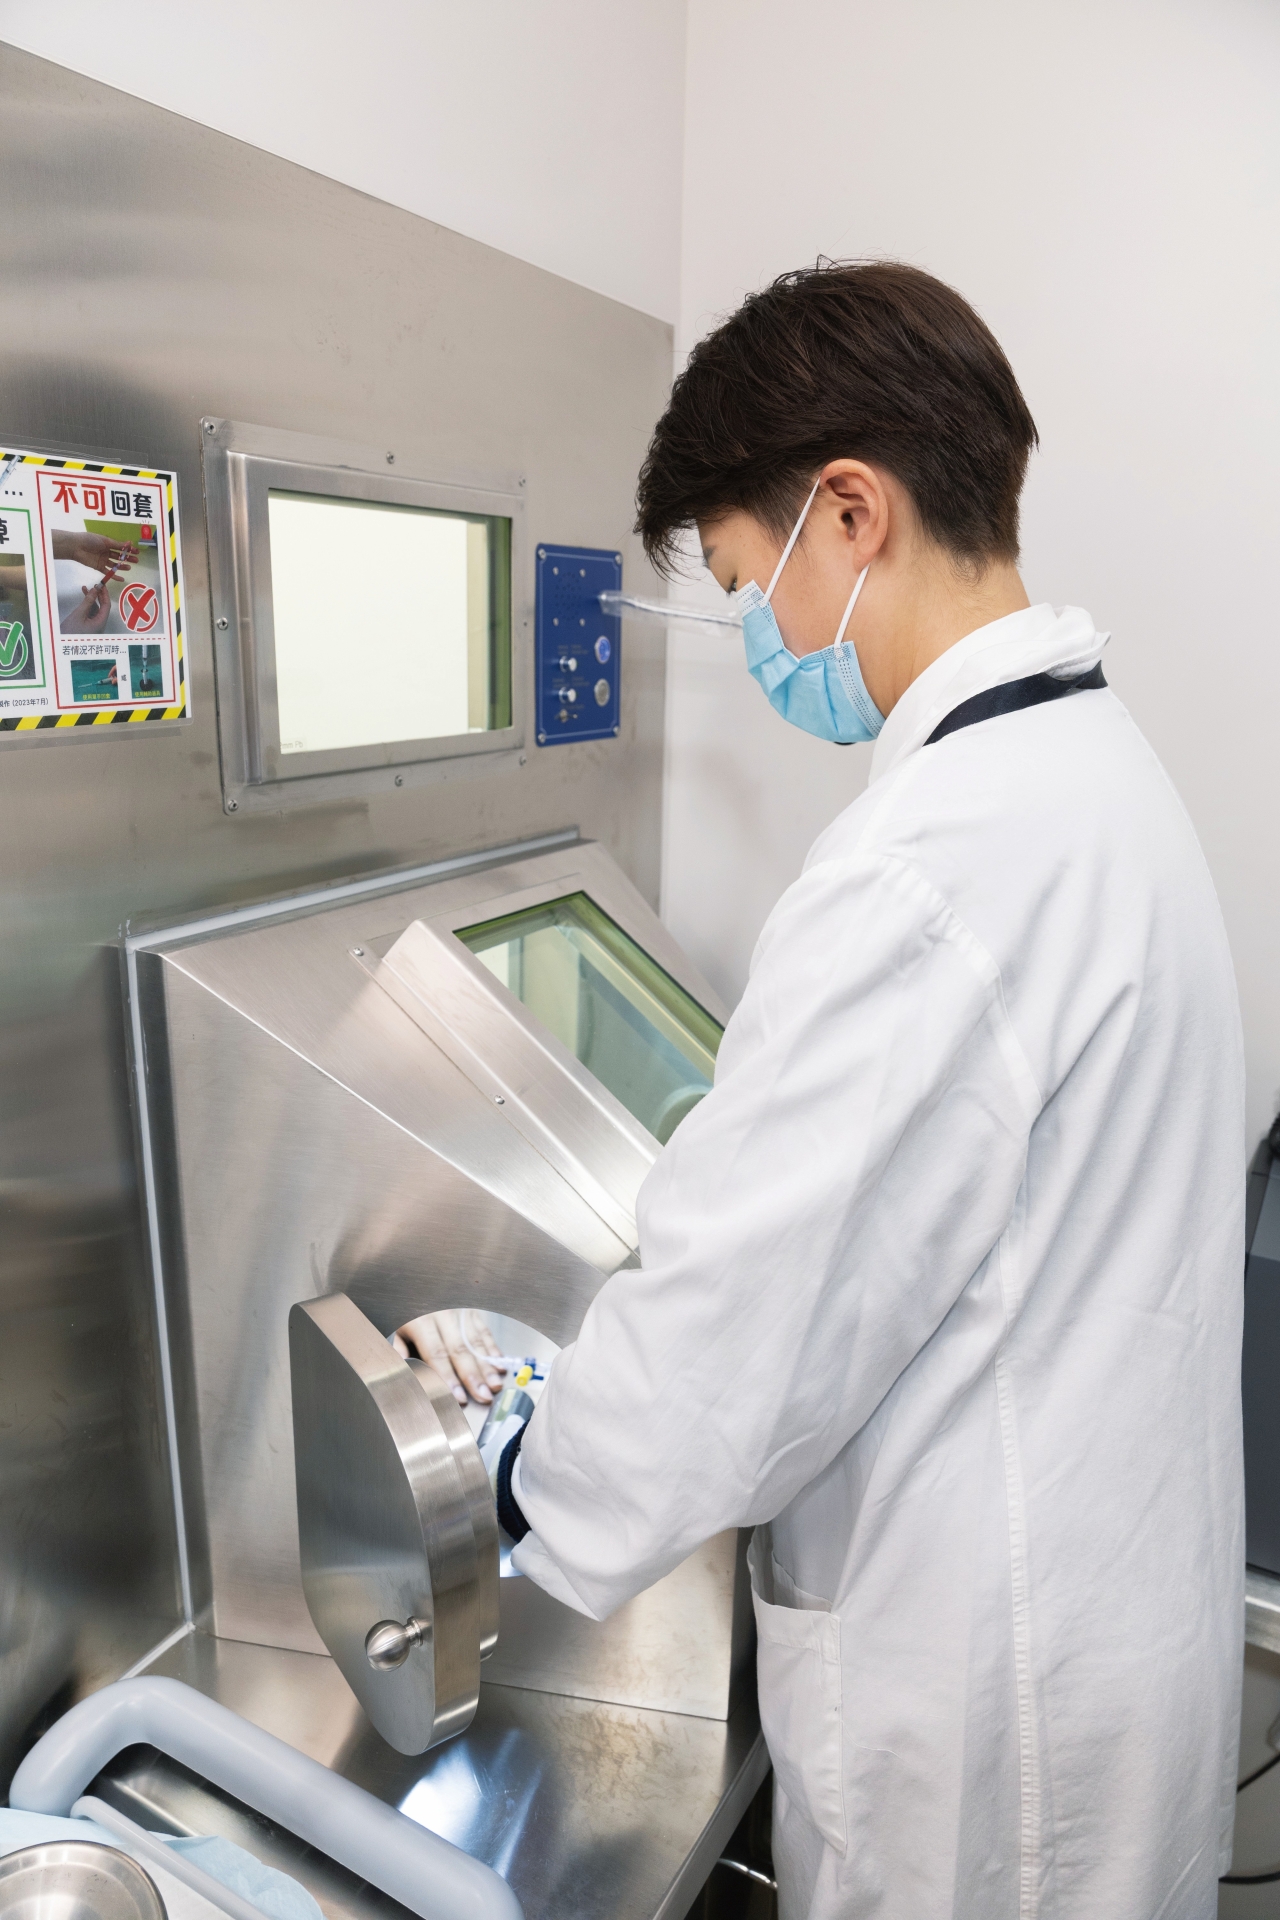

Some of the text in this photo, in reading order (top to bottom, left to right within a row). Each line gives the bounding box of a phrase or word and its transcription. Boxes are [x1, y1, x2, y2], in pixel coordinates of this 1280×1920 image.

[52, 480, 153, 519] 不可回套
[12, 697, 48, 707] (2023年7月)
